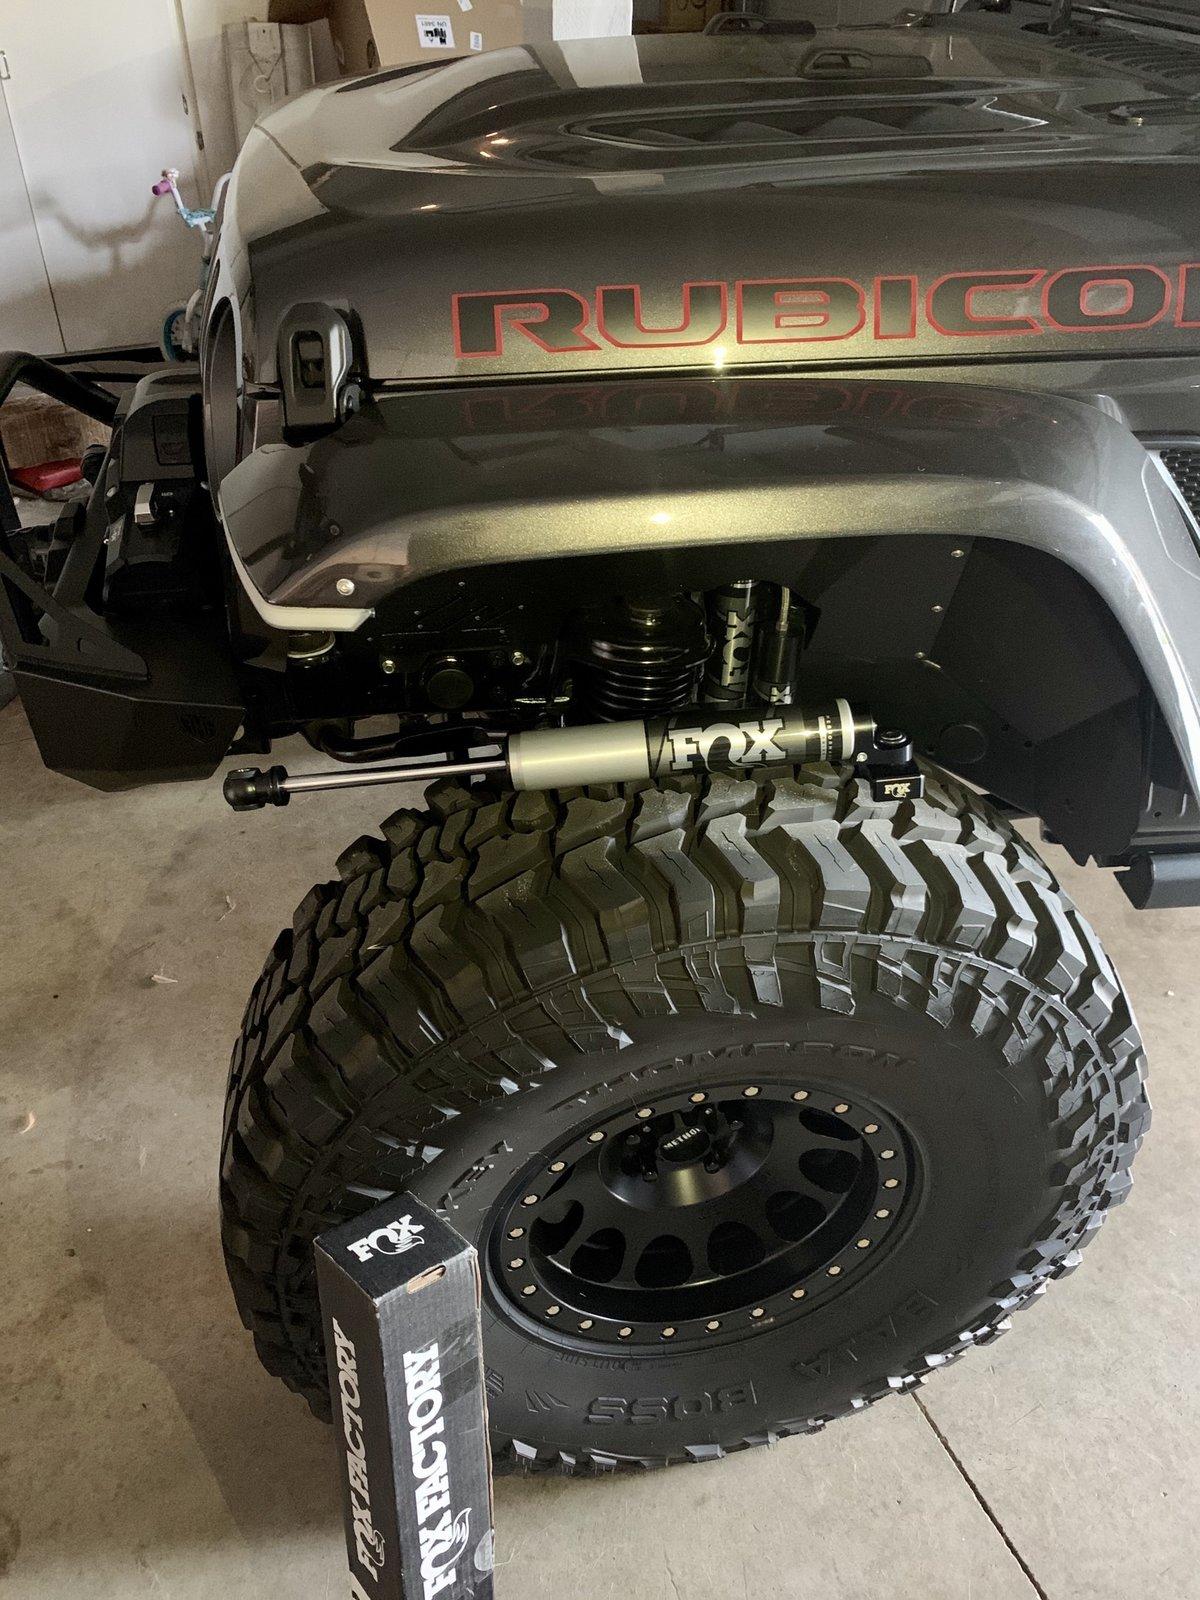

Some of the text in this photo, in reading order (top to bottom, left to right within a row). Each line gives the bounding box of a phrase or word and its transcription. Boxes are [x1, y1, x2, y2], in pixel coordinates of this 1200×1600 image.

[720, 610, 755, 687] FOX
[668, 718, 787, 773] FOX
[884, 782, 911, 798] FOX
[346, 1214, 425, 1263] FOX
[332, 1316, 386, 1583] FOX FACTORY
[403, 1342, 473, 1600] FOX FACTORY
